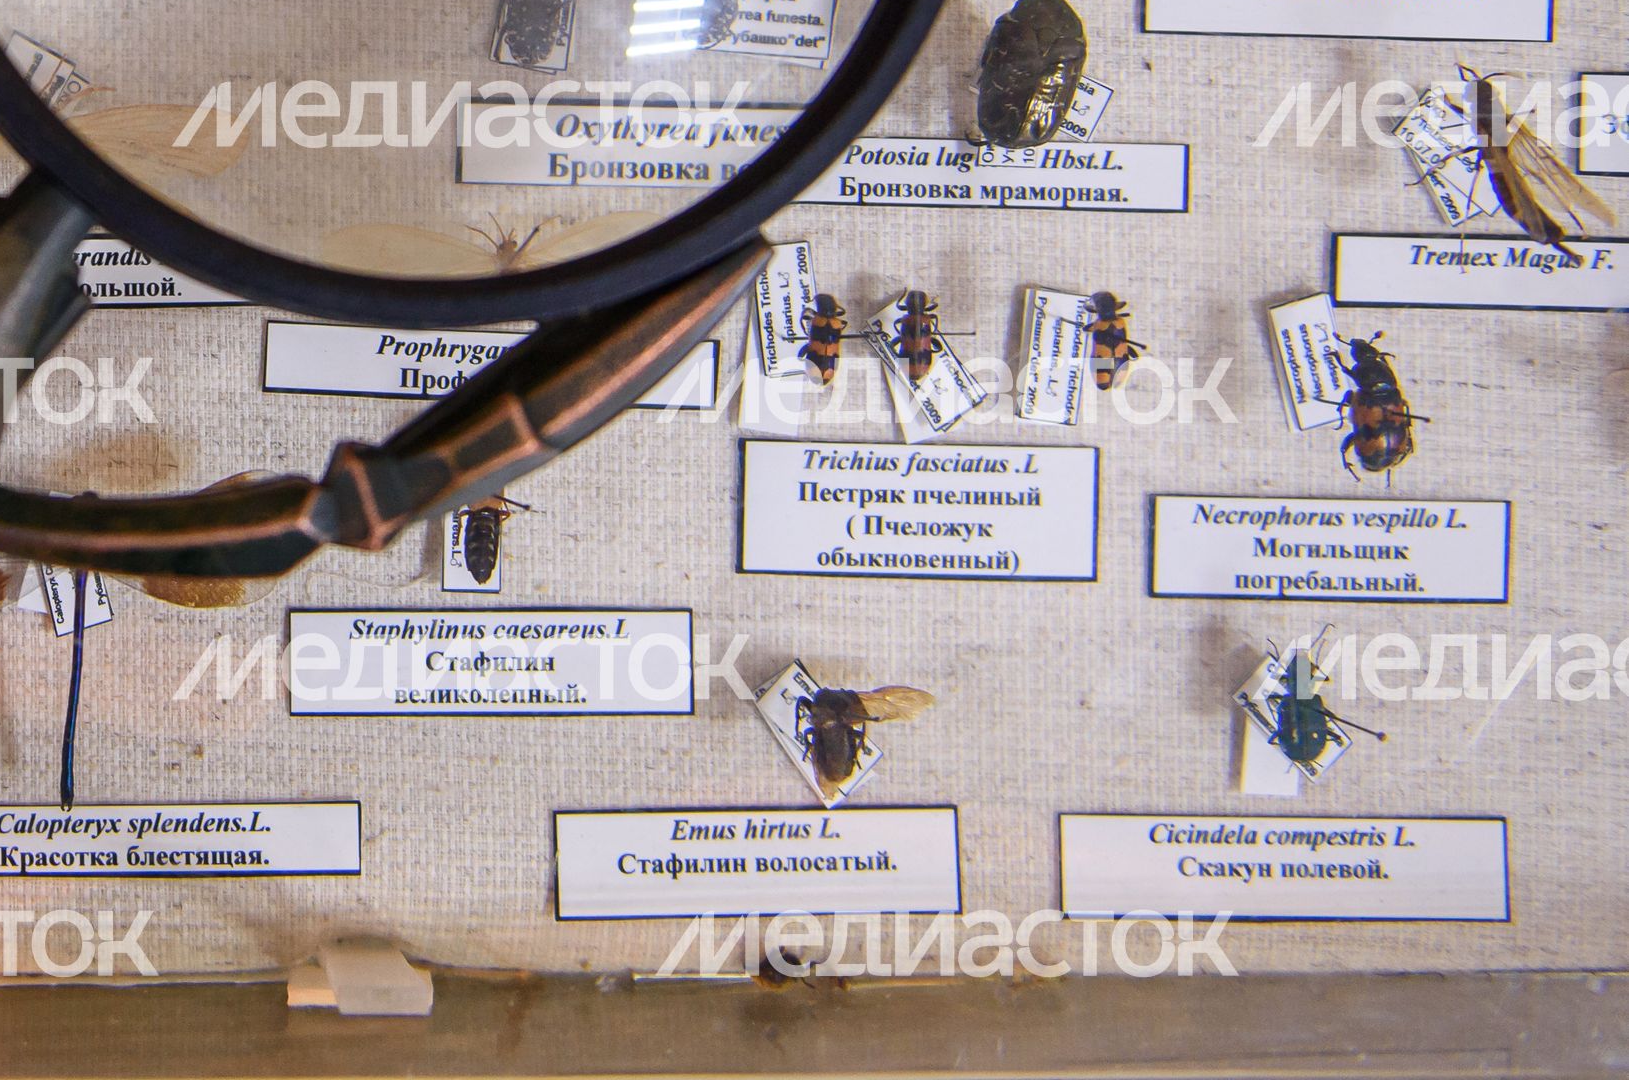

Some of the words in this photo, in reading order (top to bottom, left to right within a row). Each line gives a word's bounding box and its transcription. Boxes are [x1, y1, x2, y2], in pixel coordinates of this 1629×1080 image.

[555, 112, 701, 143] Oxythyrea
[548, 153, 709, 181] Бронзовка
[845, 145, 929, 171] Potosia
[839, 179, 972, 203] Бронзовка
[981, 179, 1129, 205] мраморная.
[1410, 245, 1497, 268] Tremex
[1592, 248, 1613, 270] F.
[804, 450, 899, 472] Trichius
[901, 450, 1009, 478] fasciatus
[798, 481, 904, 508] Пестряк
[913, 486, 1041, 507] пчелиный
[864, 515, 992, 541] Пчеложук
[1192, 503, 1346, 530] Necrophorus
[1352, 507, 1438, 530] vespillo
[1447, 508, 1467, 529] L.
[817, 548, 1019, 575] обыкновенный)
[1252, 537, 1409, 562] Могильщик
[1235, 571, 1424, 596] погребальный.
[349, 618, 485, 646] Staphylinus
[425, 649, 555, 676] Стафилин
[129, 812, 271, 840] splendens.L.
[671, 818, 736, 842] Emus
[744, 818, 811, 842] hirtus
[819, 818, 840, 842] L.
[1149, 824, 1259, 848] Cicindela
[1393, 827, 1415, 848] L.
[0, 845, 118, 873] Красотка
[127, 845, 269, 870] блестящая.
[616, 851, 748, 880] Стафилин
[756, 851, 897, 879] волосатый.
[1177, 855, 1272, 885] Скакун
[1281, 857, 1389, 883] полевой.
